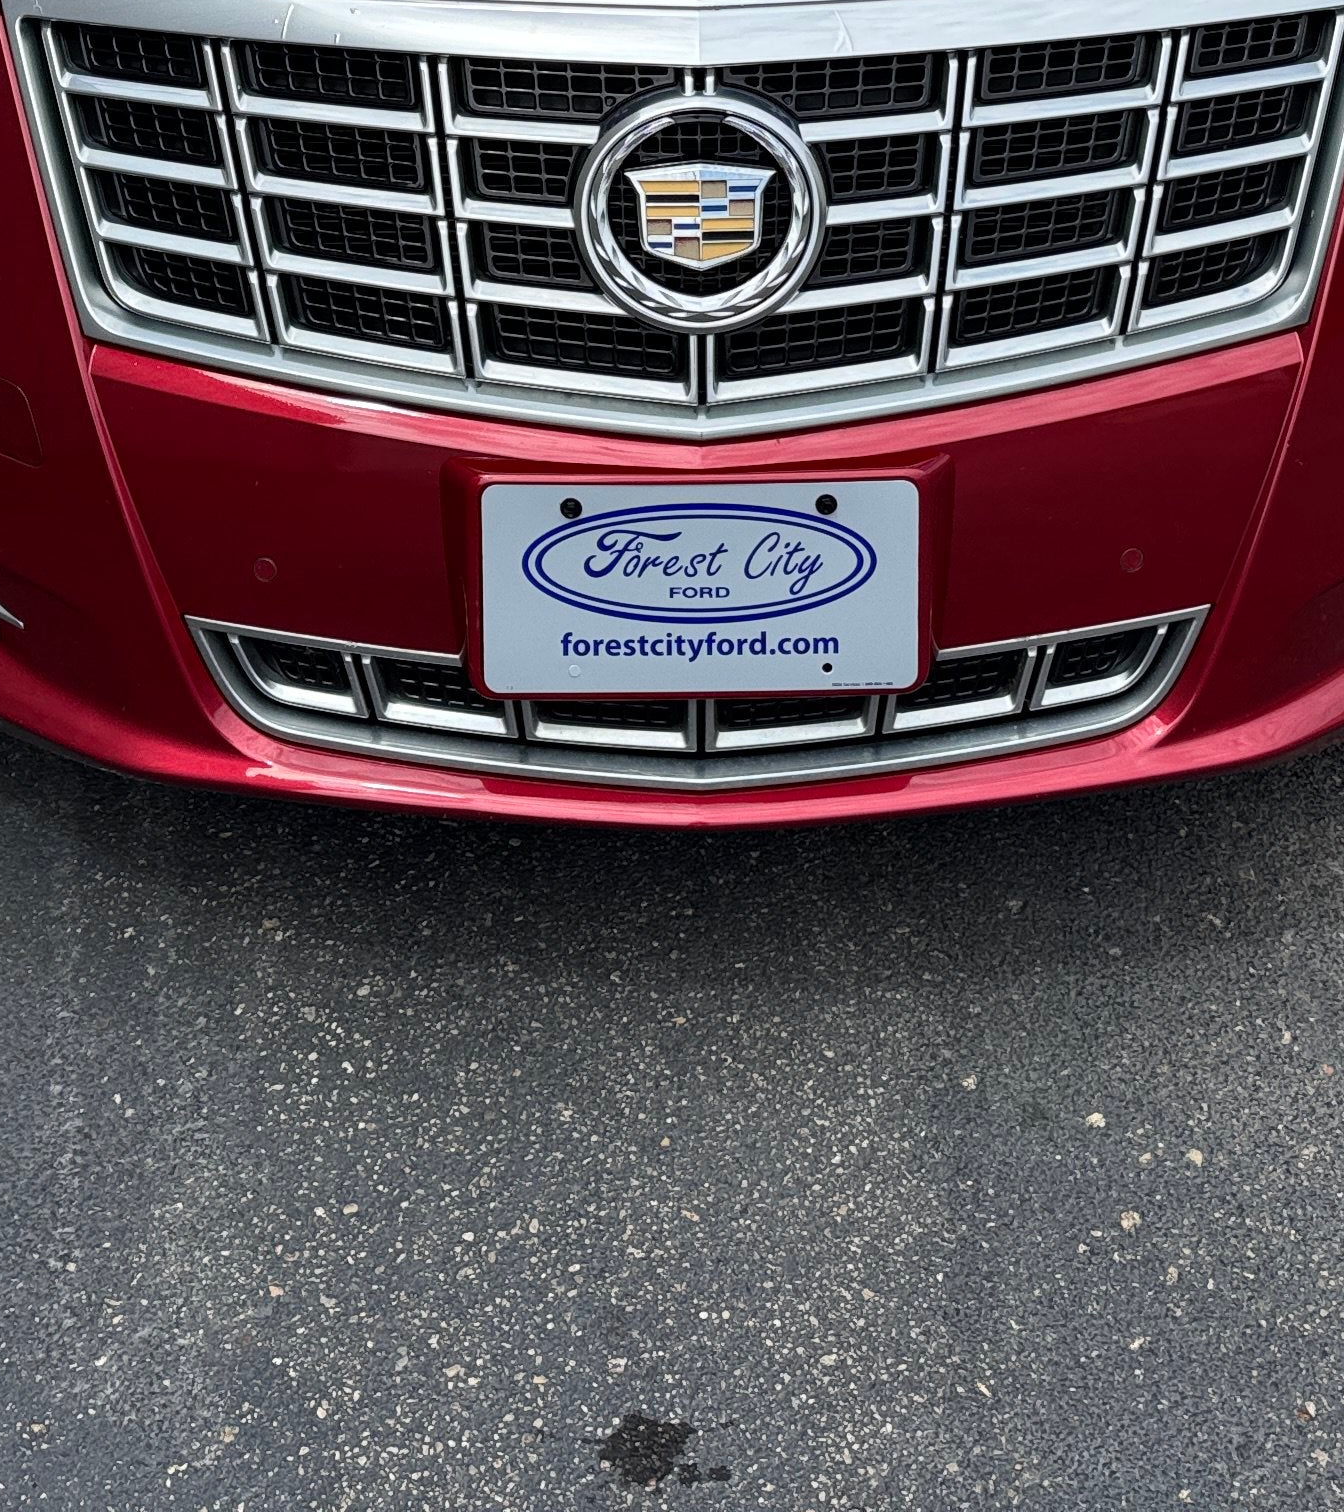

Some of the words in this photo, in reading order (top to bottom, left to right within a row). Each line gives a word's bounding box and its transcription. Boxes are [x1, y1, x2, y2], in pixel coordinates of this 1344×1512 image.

[584, 529, 729, 579] Forest
[744, 531, 824, 596] City
[669, 586, 731, 599] FORD
[560, 631, 840, 663] forestcityford.com
